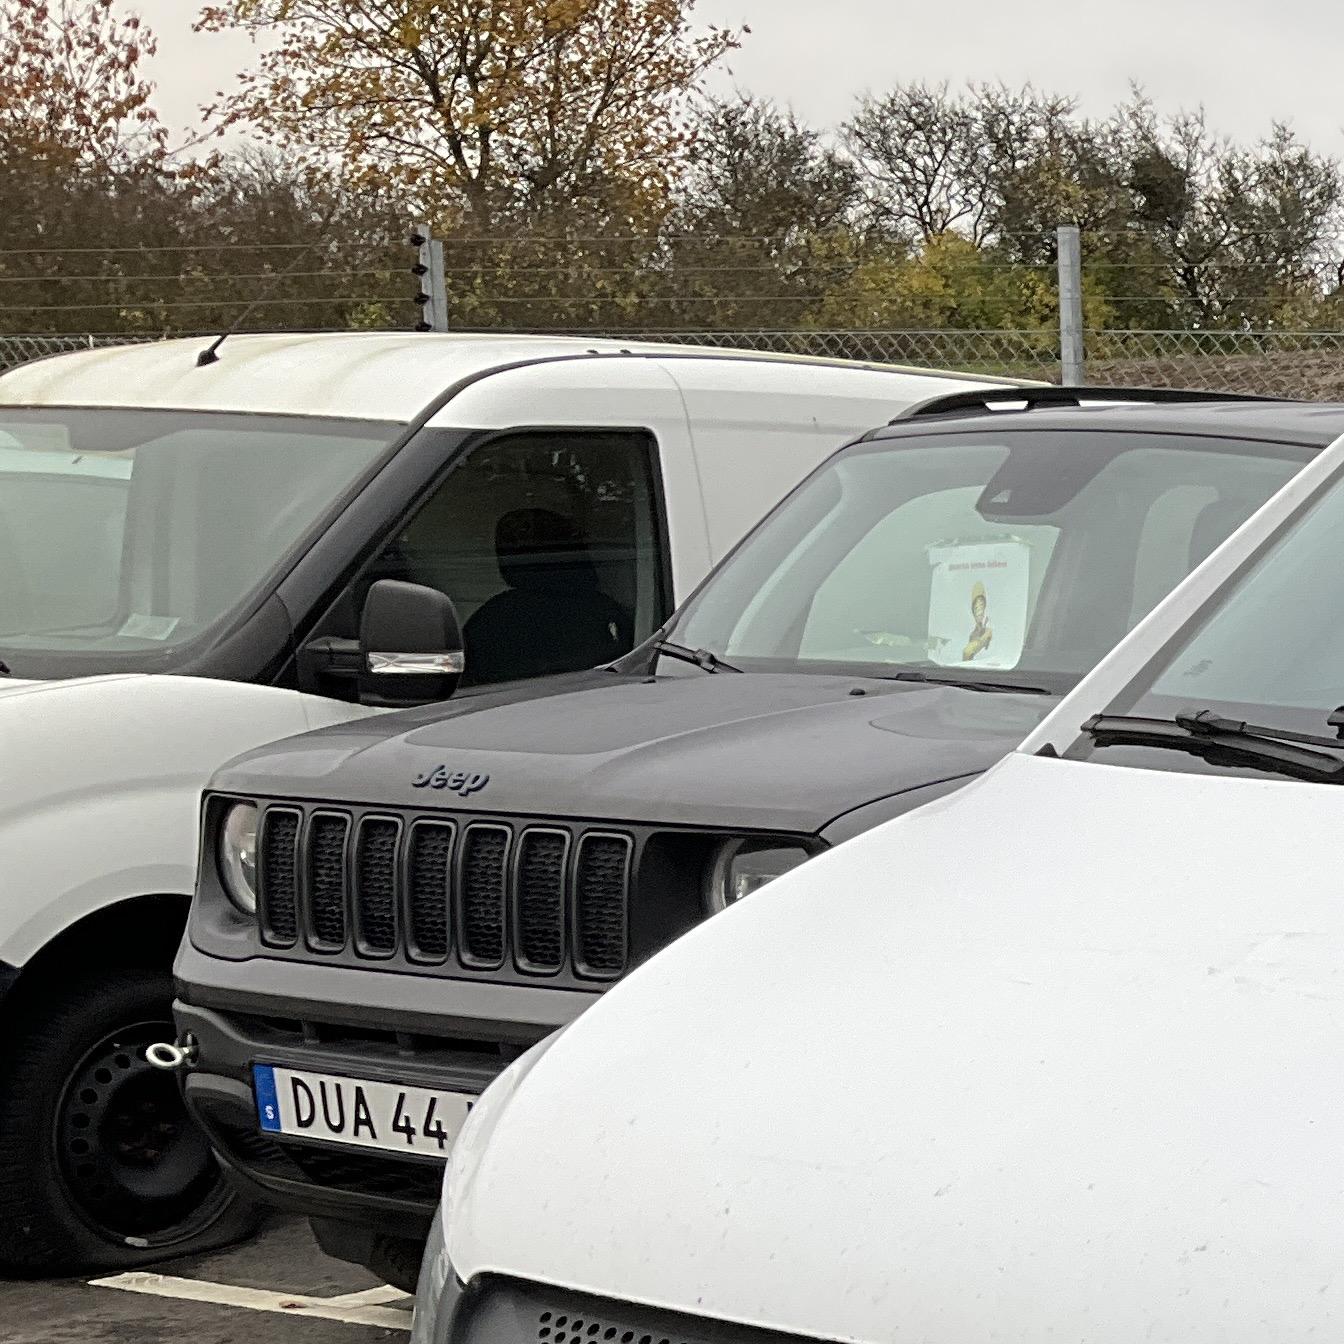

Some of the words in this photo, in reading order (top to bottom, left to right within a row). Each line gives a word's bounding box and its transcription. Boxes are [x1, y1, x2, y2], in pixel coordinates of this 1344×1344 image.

[411, 764, 490, 797] Jeep
[265, 1105, 275, 1120] S
[291, 1076, 377, 1139] DUA
[392, 1092, 475, 1149] 44
